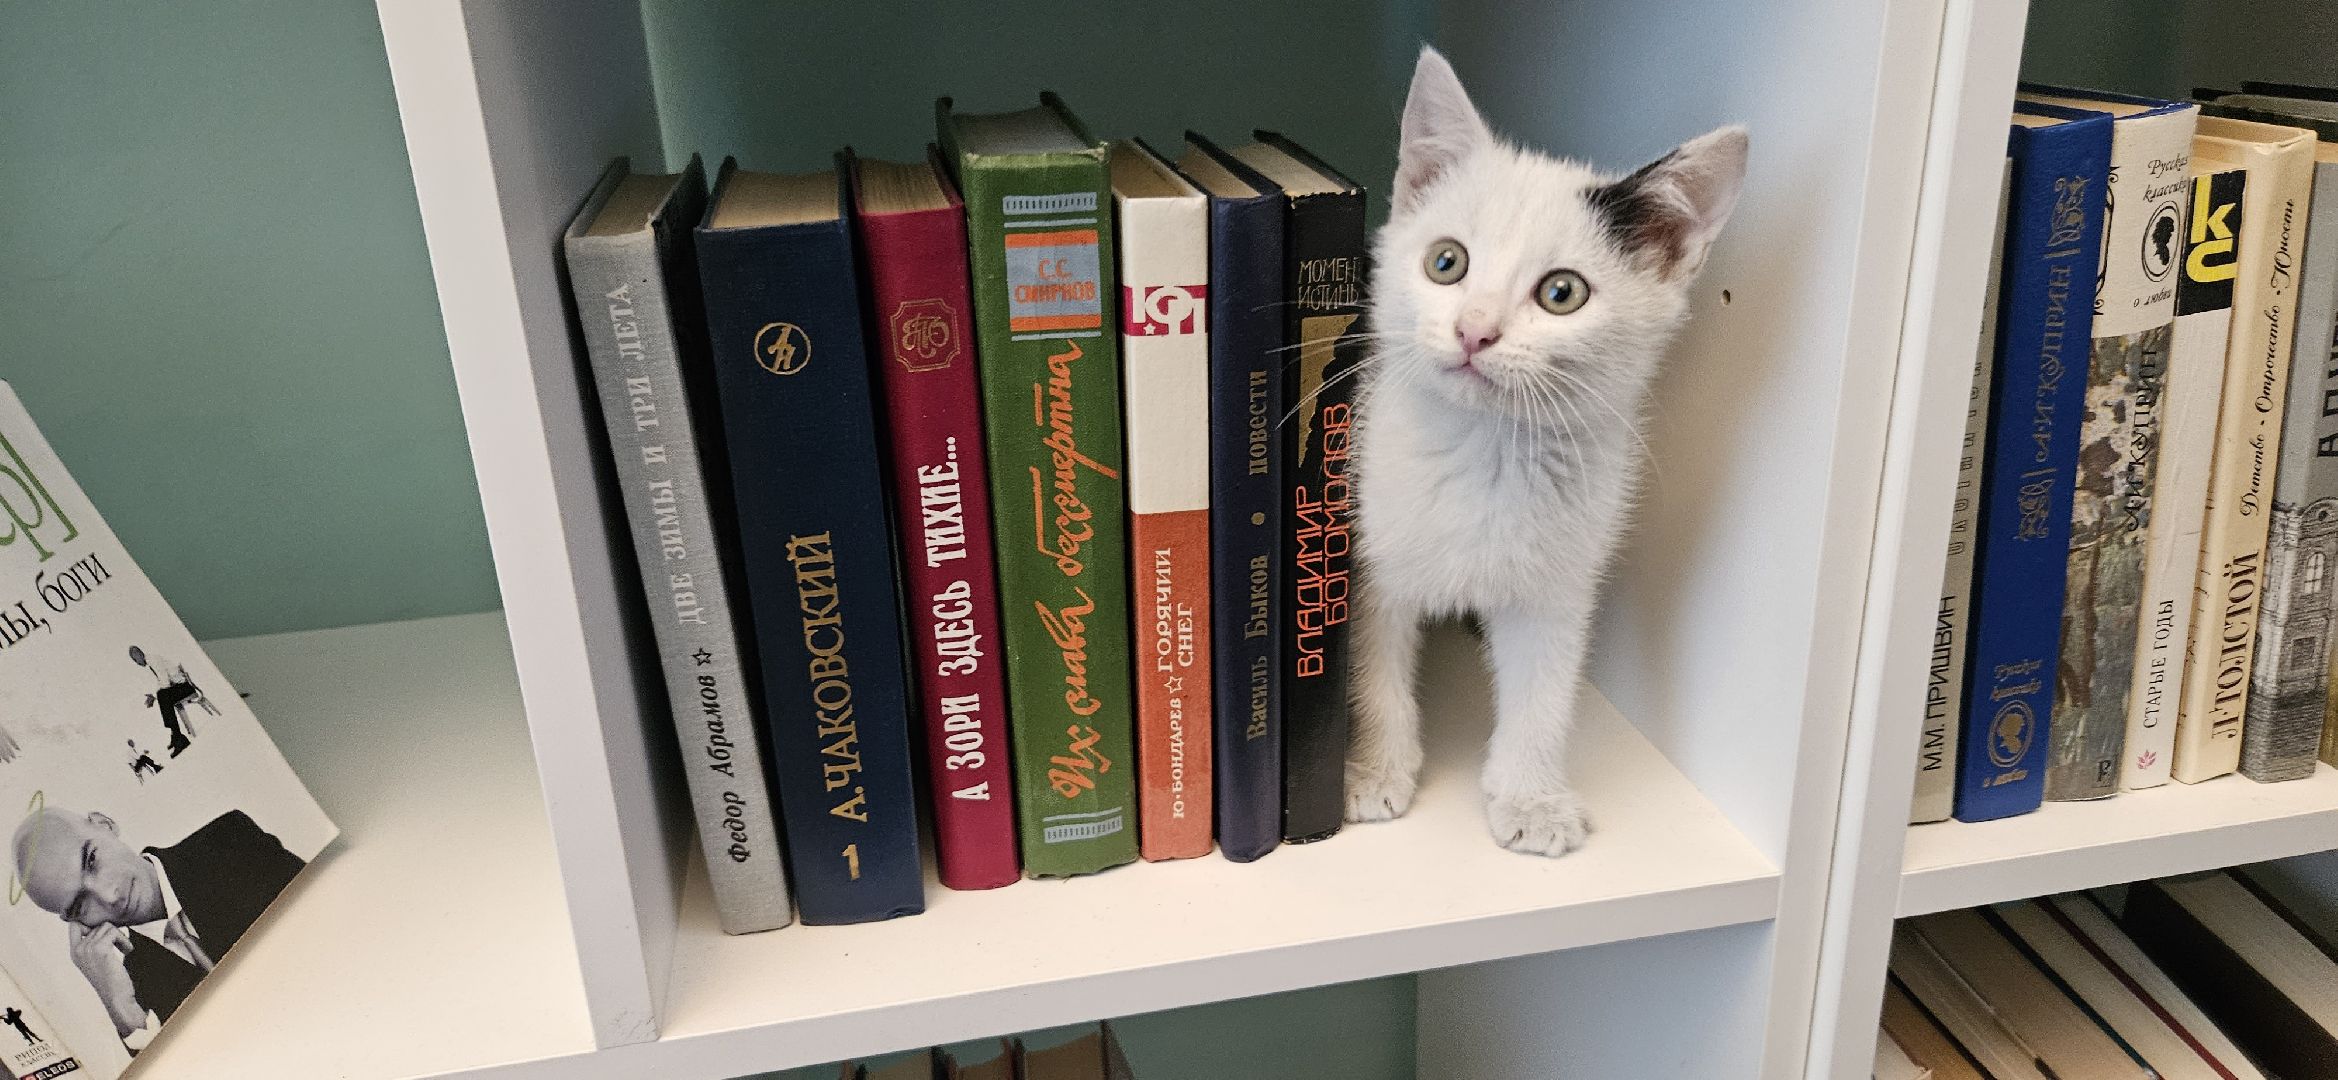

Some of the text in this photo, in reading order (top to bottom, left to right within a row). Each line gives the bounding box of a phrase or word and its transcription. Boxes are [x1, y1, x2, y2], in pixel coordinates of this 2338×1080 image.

[2240, 198, 2294, 517] Детство Отрочество Юность
[605, 283, 707, 625] ДВЕ ЗИМЫ И ТРИ ЛЕТА
[1323, 403, 1351, 626] БОГОМОЛОВ
[35, 552, 112, 613] боги
[918, 436, 990, 801] А ЗОРИ ЗДЕСЬ ТИХИЕ...
[1153, 547, 1172, 673] ГОРЯЧИЙ
[1177, 602, 1193, 668] СНЕГ
[1244, 552, 1270, 640] Быков
[1296, 485, 1327, 677] ВЛАДИМИР
[1035, 586, 1101, 716] слава
[1246, 655, 1269, 742] Василь
[1926, 595, 1956, 720] ПРИШВИН
[2143, 600, 2174, 728] СТАРЫЕ ГОДЫ
[700, 675, 750, 863] Федор Абрамов
[1049, 724, 1112, 798] Их
[841, 844, 861, 880] 1
